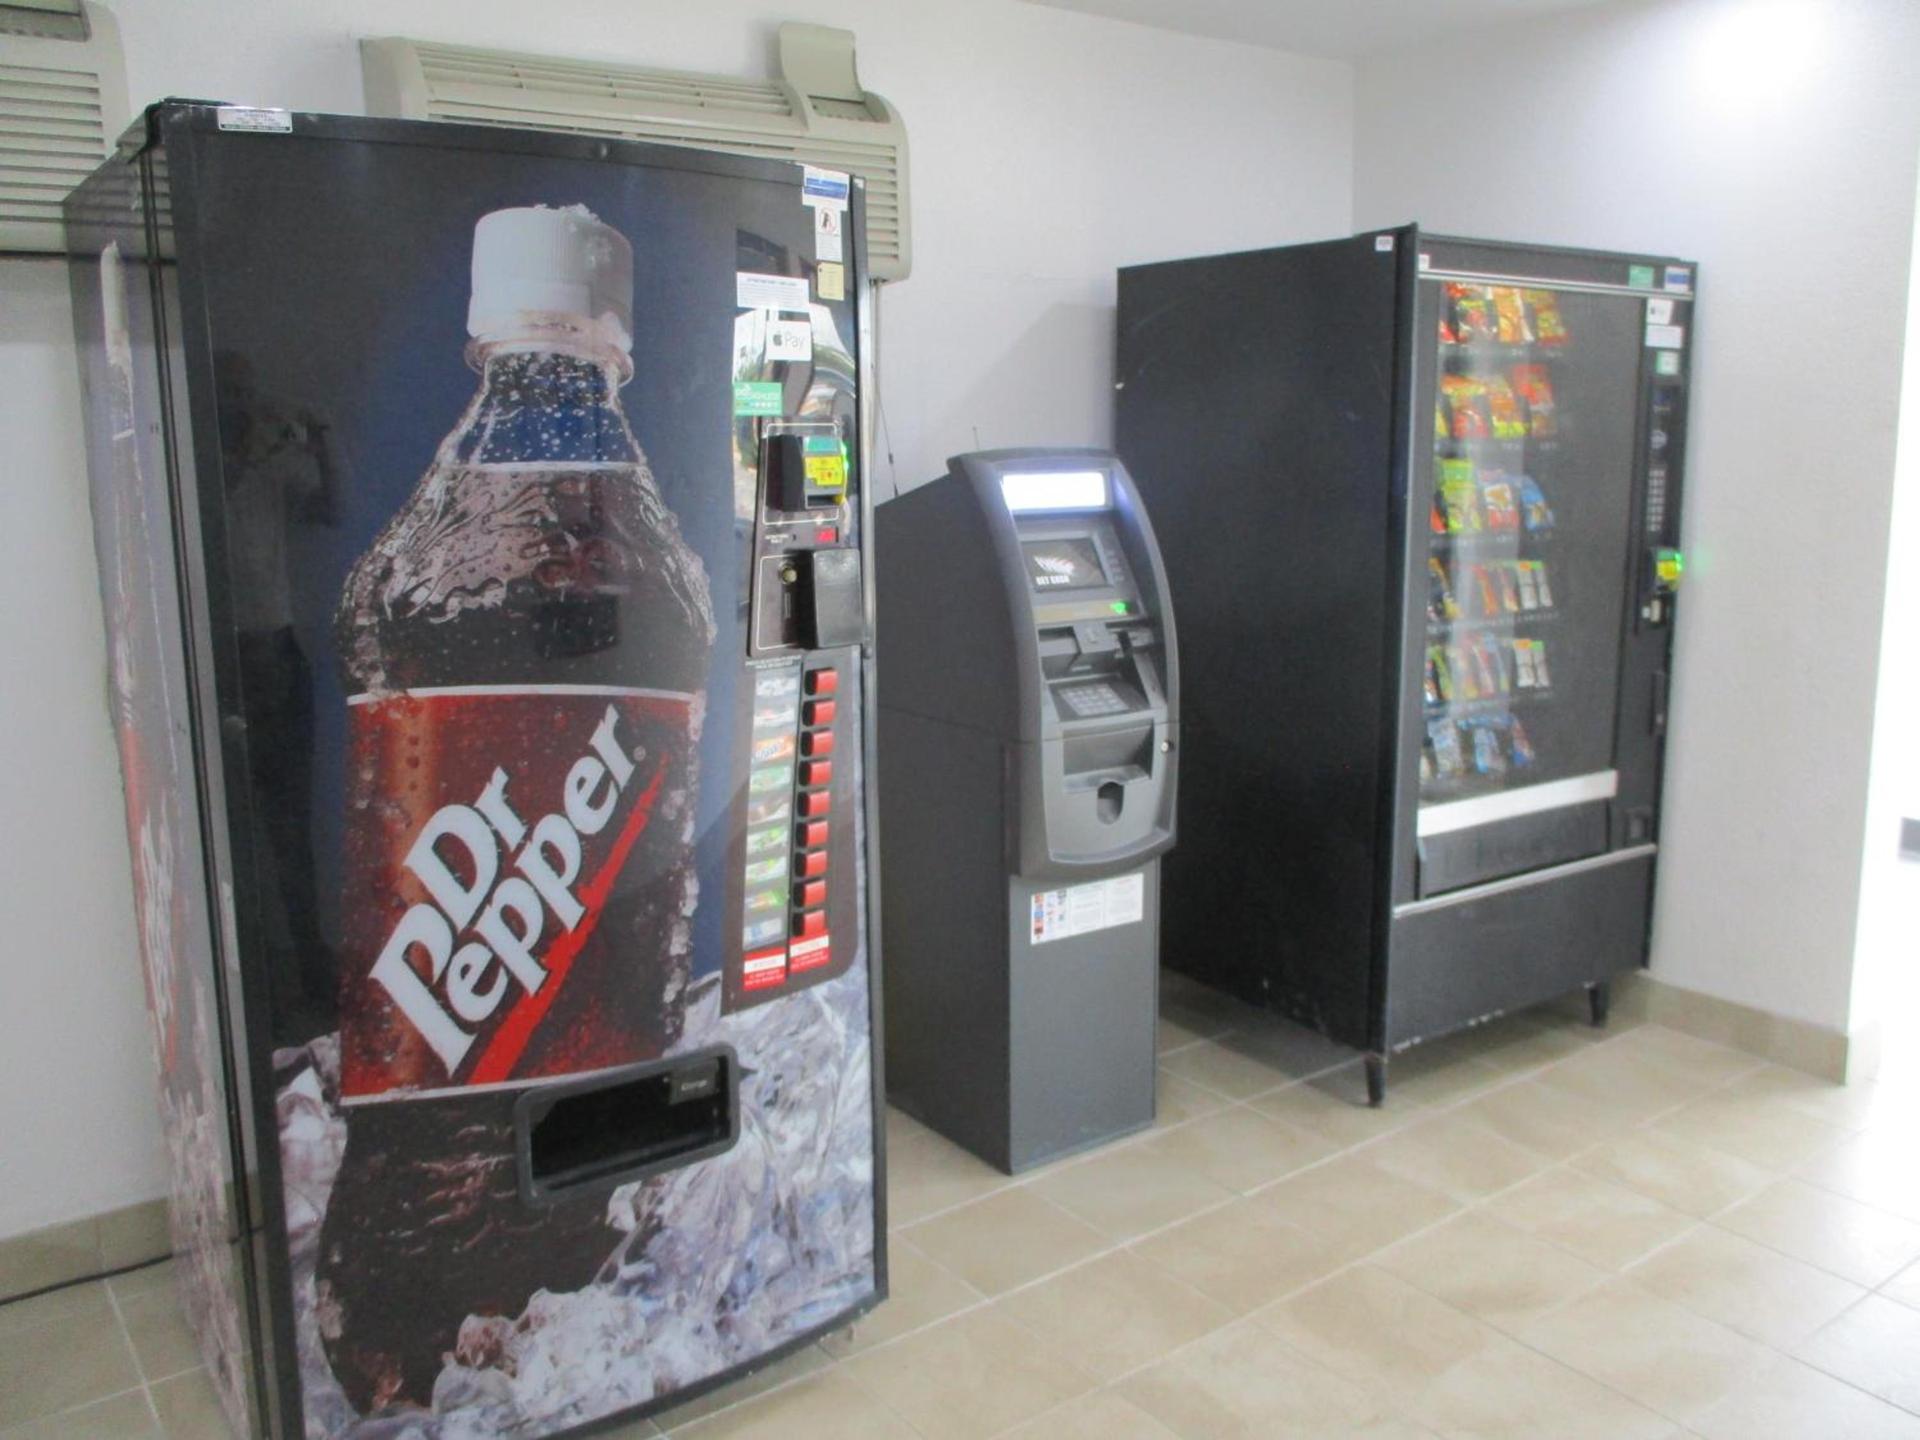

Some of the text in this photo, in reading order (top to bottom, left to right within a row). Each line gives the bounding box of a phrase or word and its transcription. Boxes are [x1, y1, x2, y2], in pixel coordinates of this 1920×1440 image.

[784, 331, 805, 352] Pay
[368, 704, 635, 1078] Pepper
[403, 766, 527, 933] Dr
